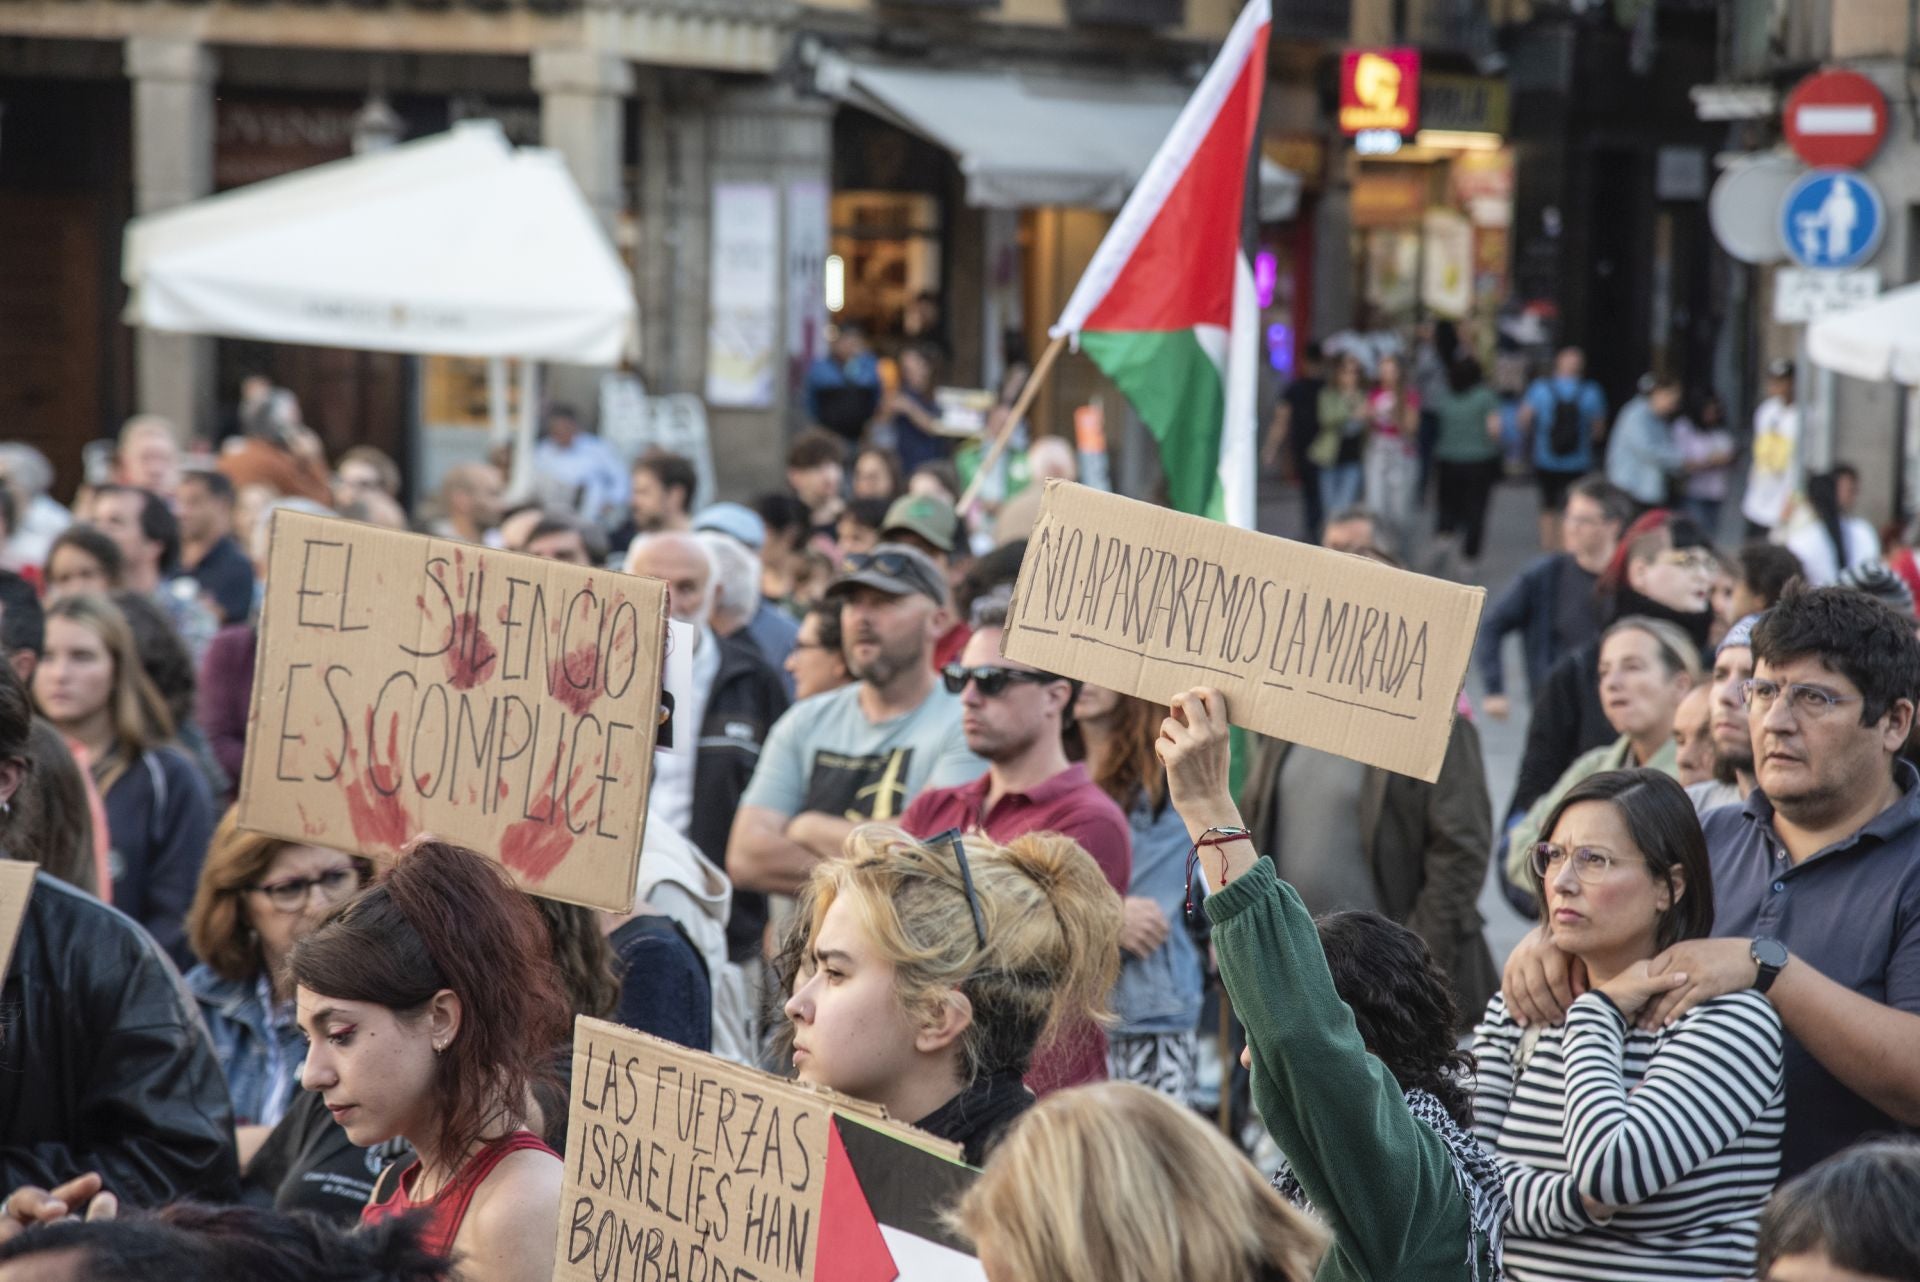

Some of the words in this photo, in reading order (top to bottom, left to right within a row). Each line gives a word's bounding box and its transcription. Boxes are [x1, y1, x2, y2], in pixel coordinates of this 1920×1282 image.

[297, 539, 369, 631] EL
[399, 557, 638, 699] SILENCIO
[1022, 525, 1083, 622] NO
[1077, 533, 1276, 664] APARTAREMOS
[1269, 588, 1307, 675] LA
[1308, 597, 1428, 700] MIRADA
[277, 663, 353, 782] ES
[582, 1042, 639, 1125] LAS
[653, 1066, 810, 1192] FUERZAS
[567, 1196, 759, 1282] BOMBAR
[577, 1122, 731, 1242] ISRAELÍES
[744, 1185, 810, 1279] HAN
